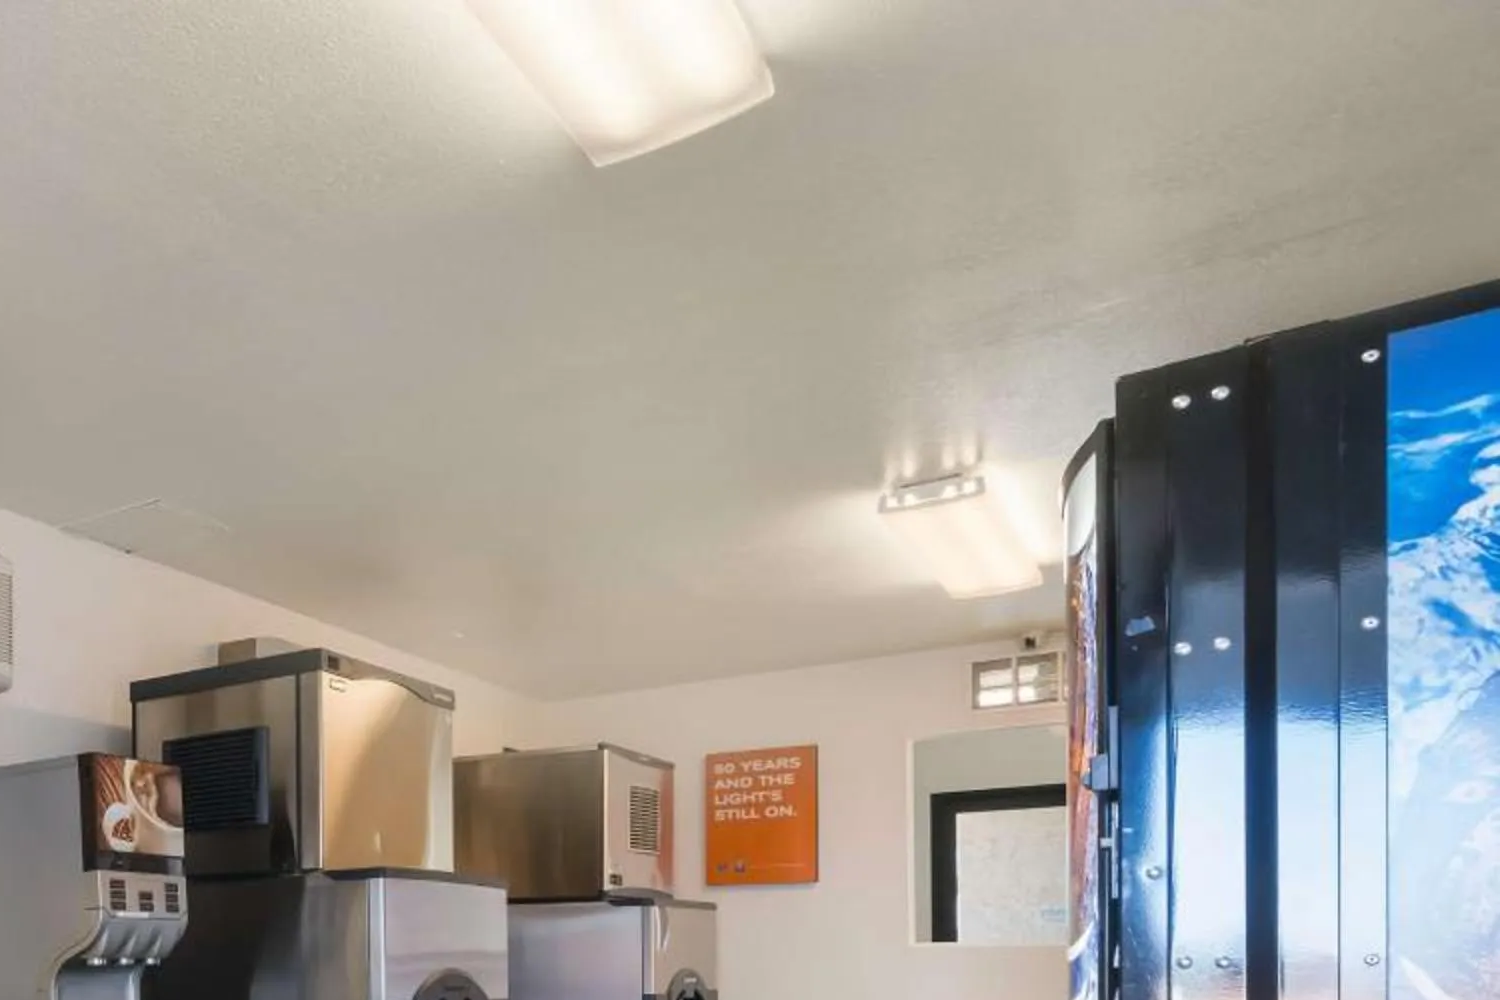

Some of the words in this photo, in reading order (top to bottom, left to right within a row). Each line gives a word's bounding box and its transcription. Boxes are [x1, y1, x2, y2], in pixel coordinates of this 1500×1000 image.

[740, 757, 802, 773] YEARS
[715, 777, 753, 789] AND
[758, 773, 796, 786] THE
[714, 809, 760, 821] STILL
[764, 804, 797, 818] ON.
